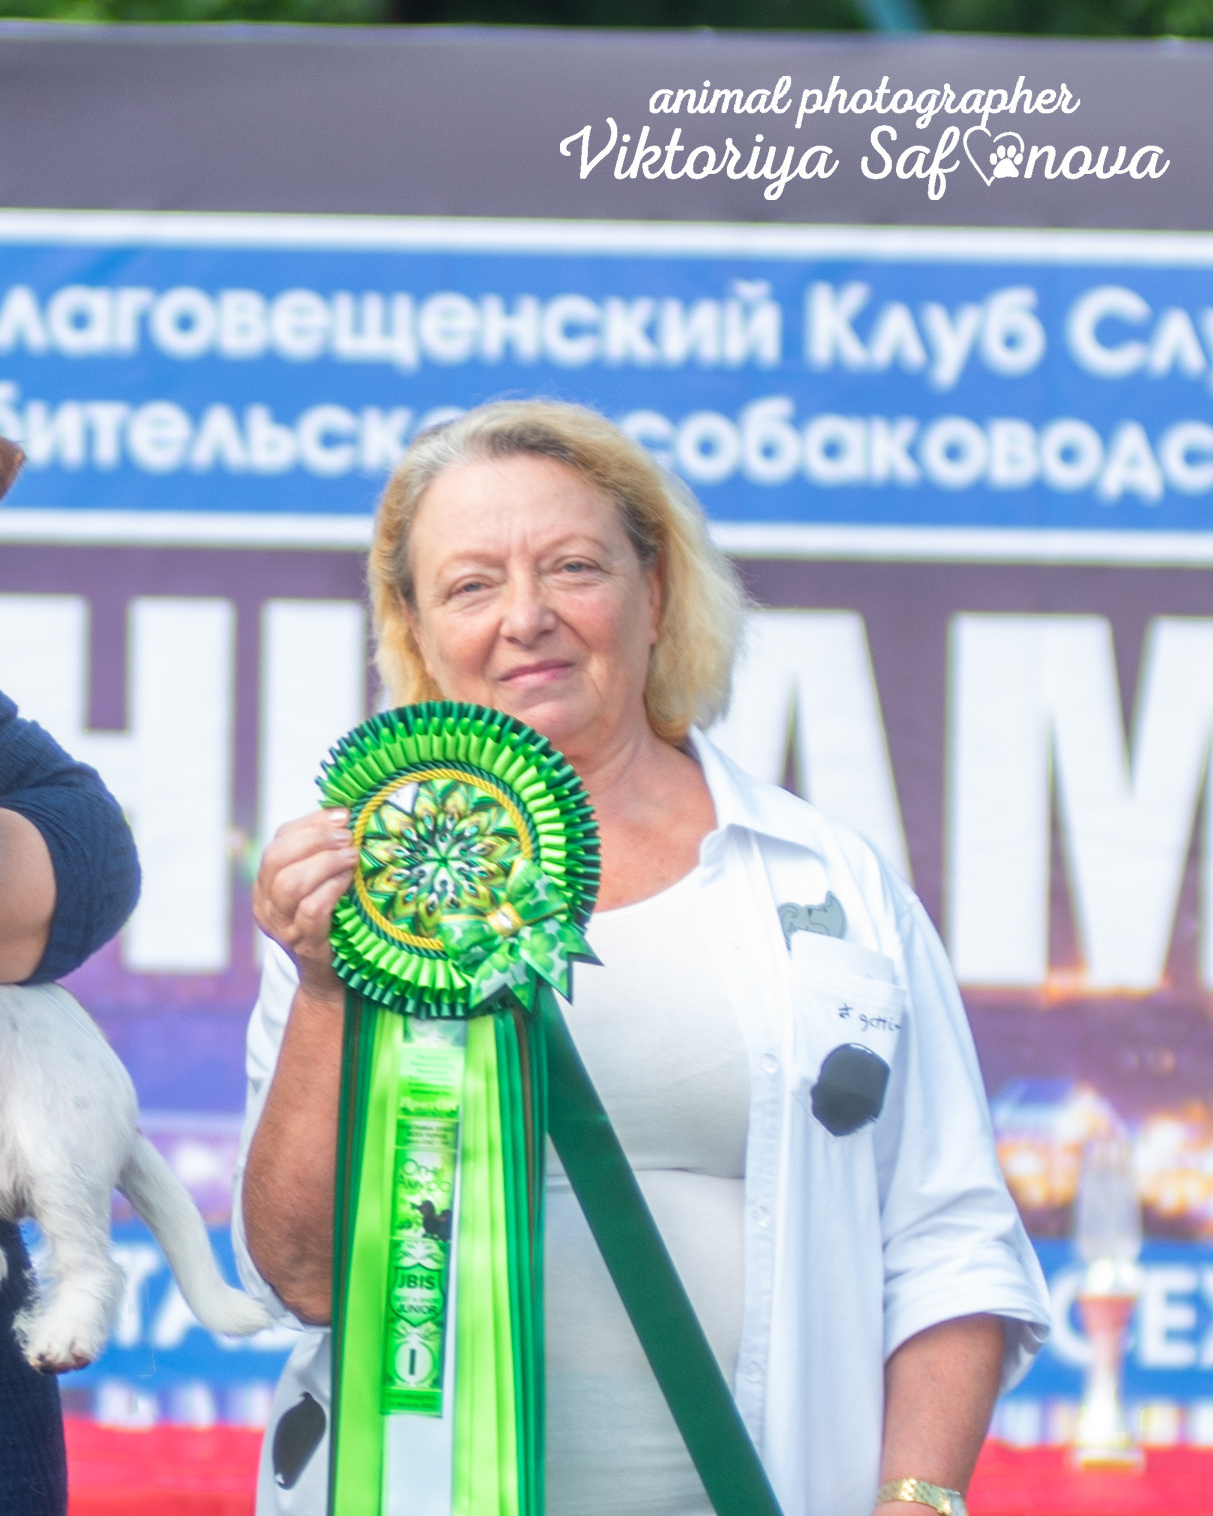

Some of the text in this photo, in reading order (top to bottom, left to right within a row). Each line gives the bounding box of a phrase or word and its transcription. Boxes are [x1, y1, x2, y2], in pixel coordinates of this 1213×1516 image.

[803, 280, 1047, 393] Клуб
[1064, 284, 1213, 398] Сл
[396, 1273, 435, 1291] JBIS
